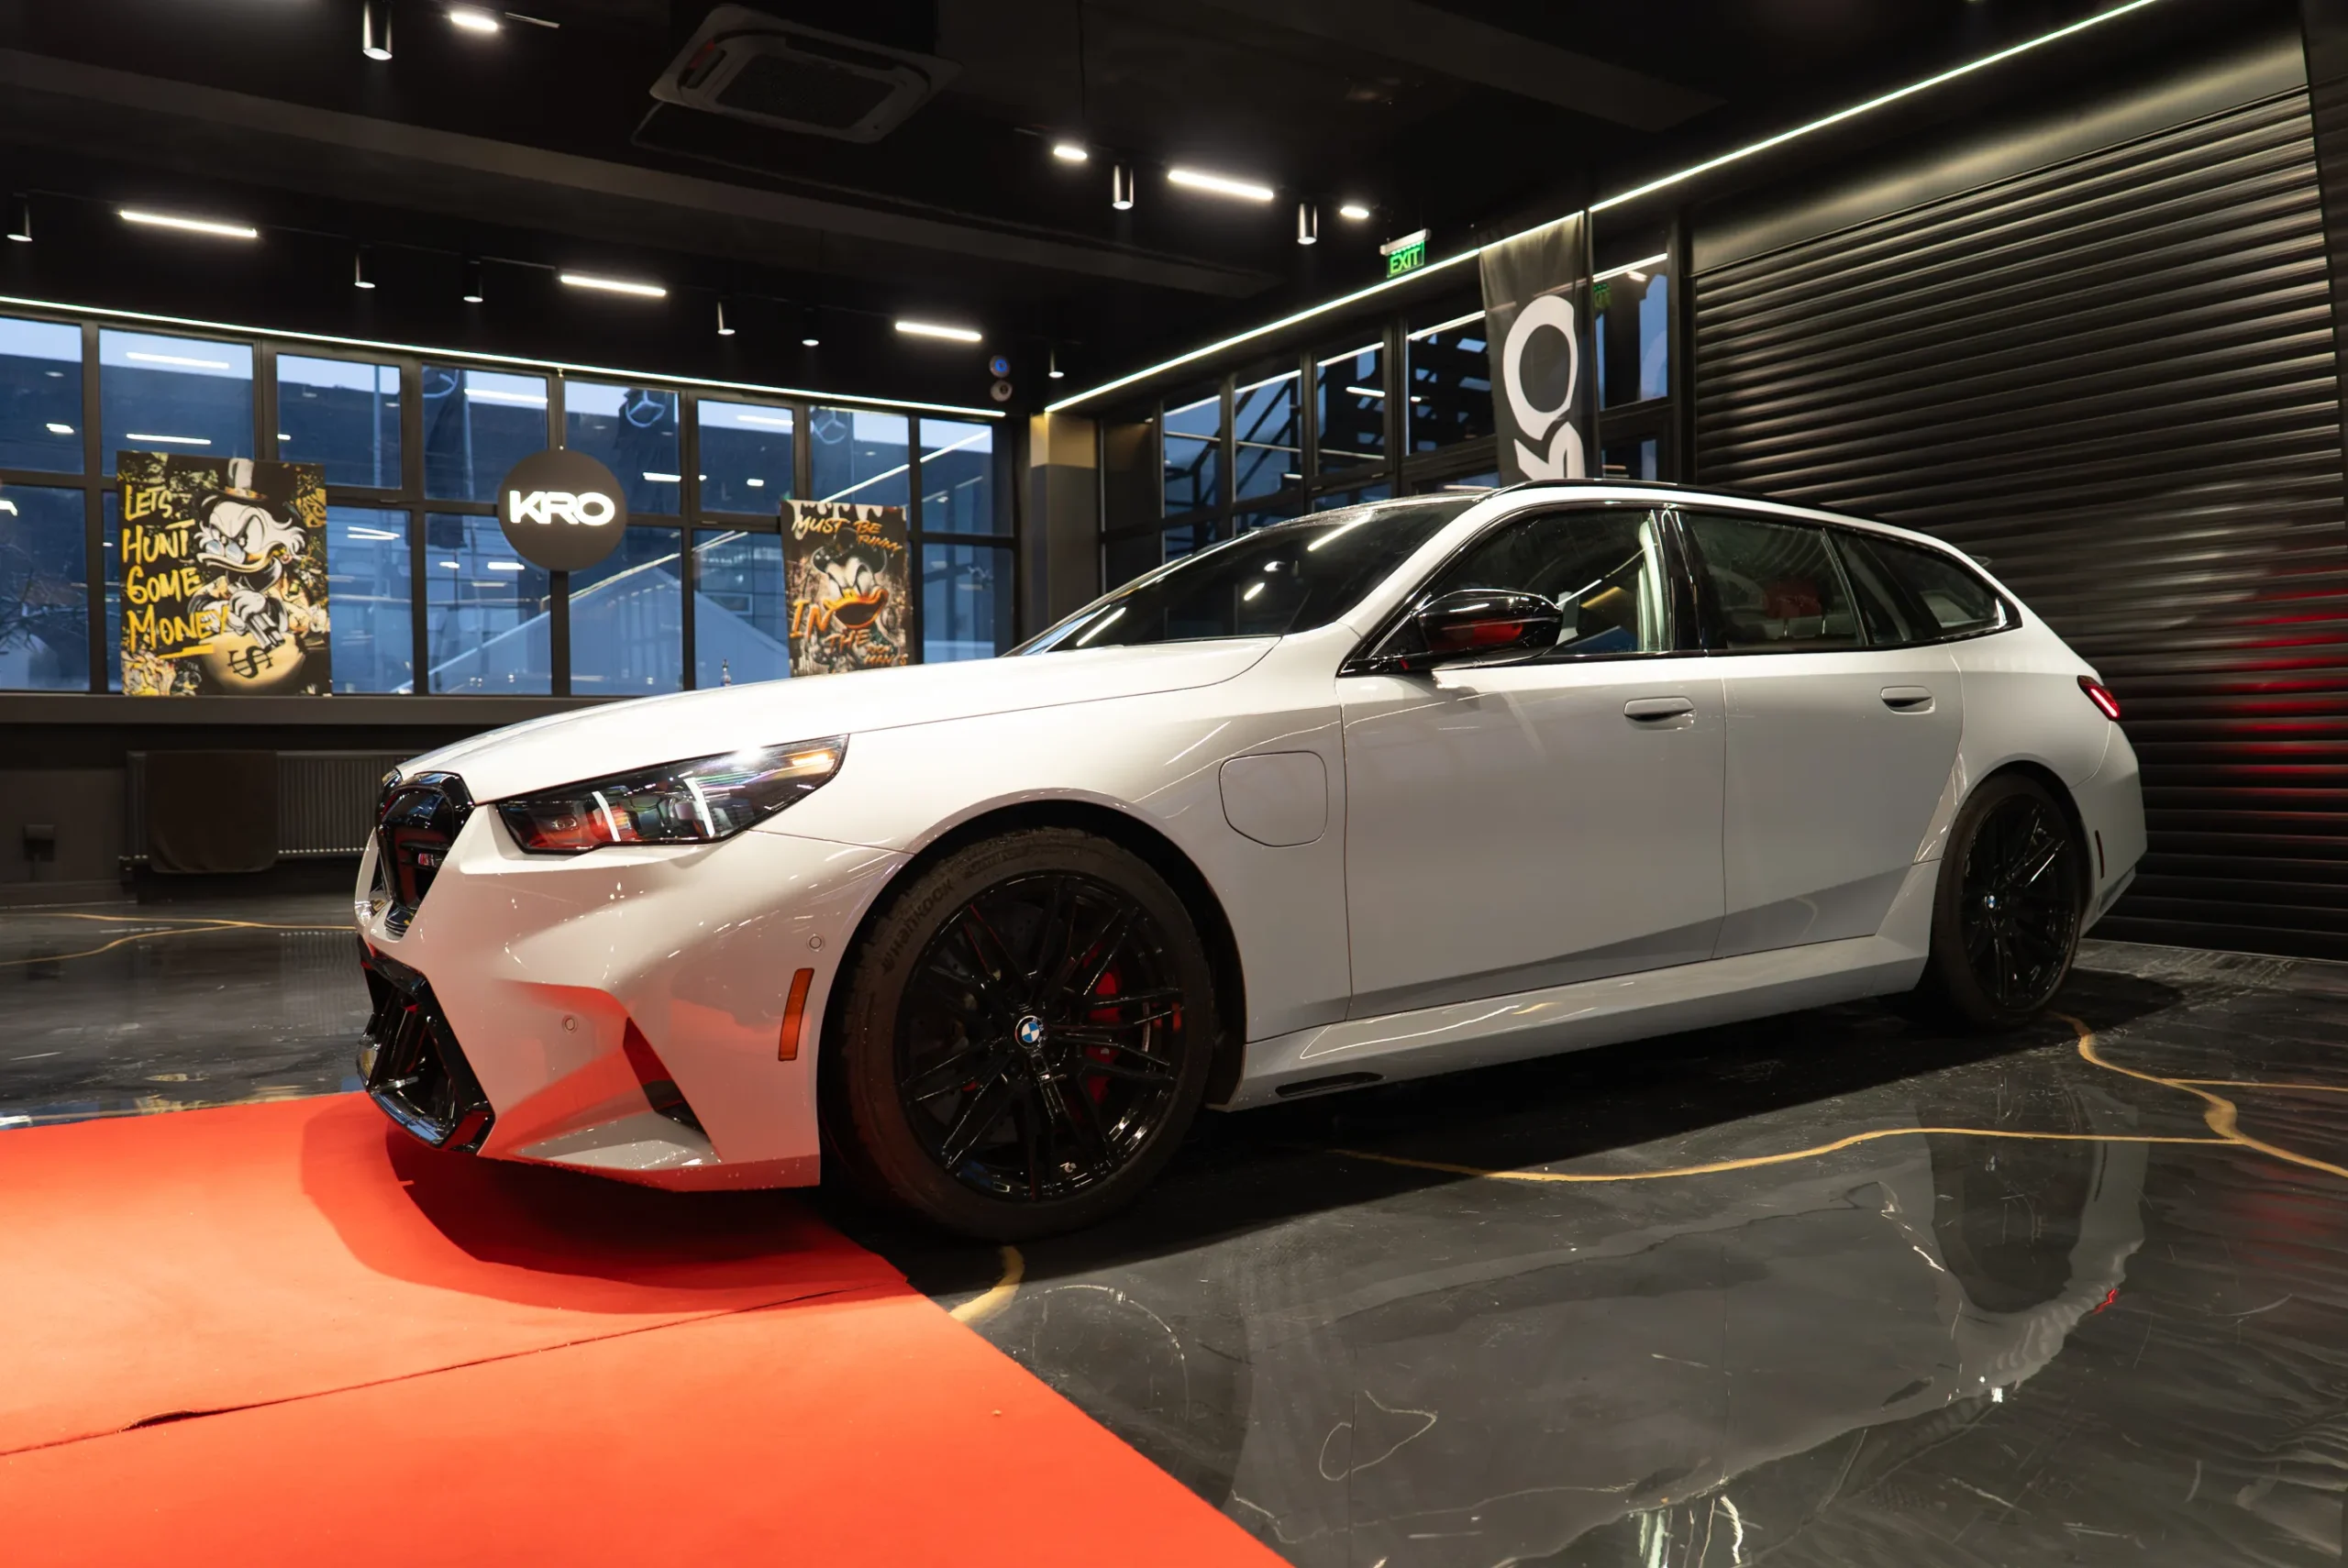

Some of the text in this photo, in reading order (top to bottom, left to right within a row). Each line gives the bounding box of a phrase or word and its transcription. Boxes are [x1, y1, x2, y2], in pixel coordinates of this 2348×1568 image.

[1390, 248, 1421, 274] EXIT
[125, 484, 173, 521] LETS
[509, 490, 615, 526] KRO
[122, 518, 196, 565] HUNT
[792, 515, 882, 538] MUST BE
[127, 603, 229, 652] MONEY
[789, 600, 834, 640] IN
[822, 628, 870, 654] THE
